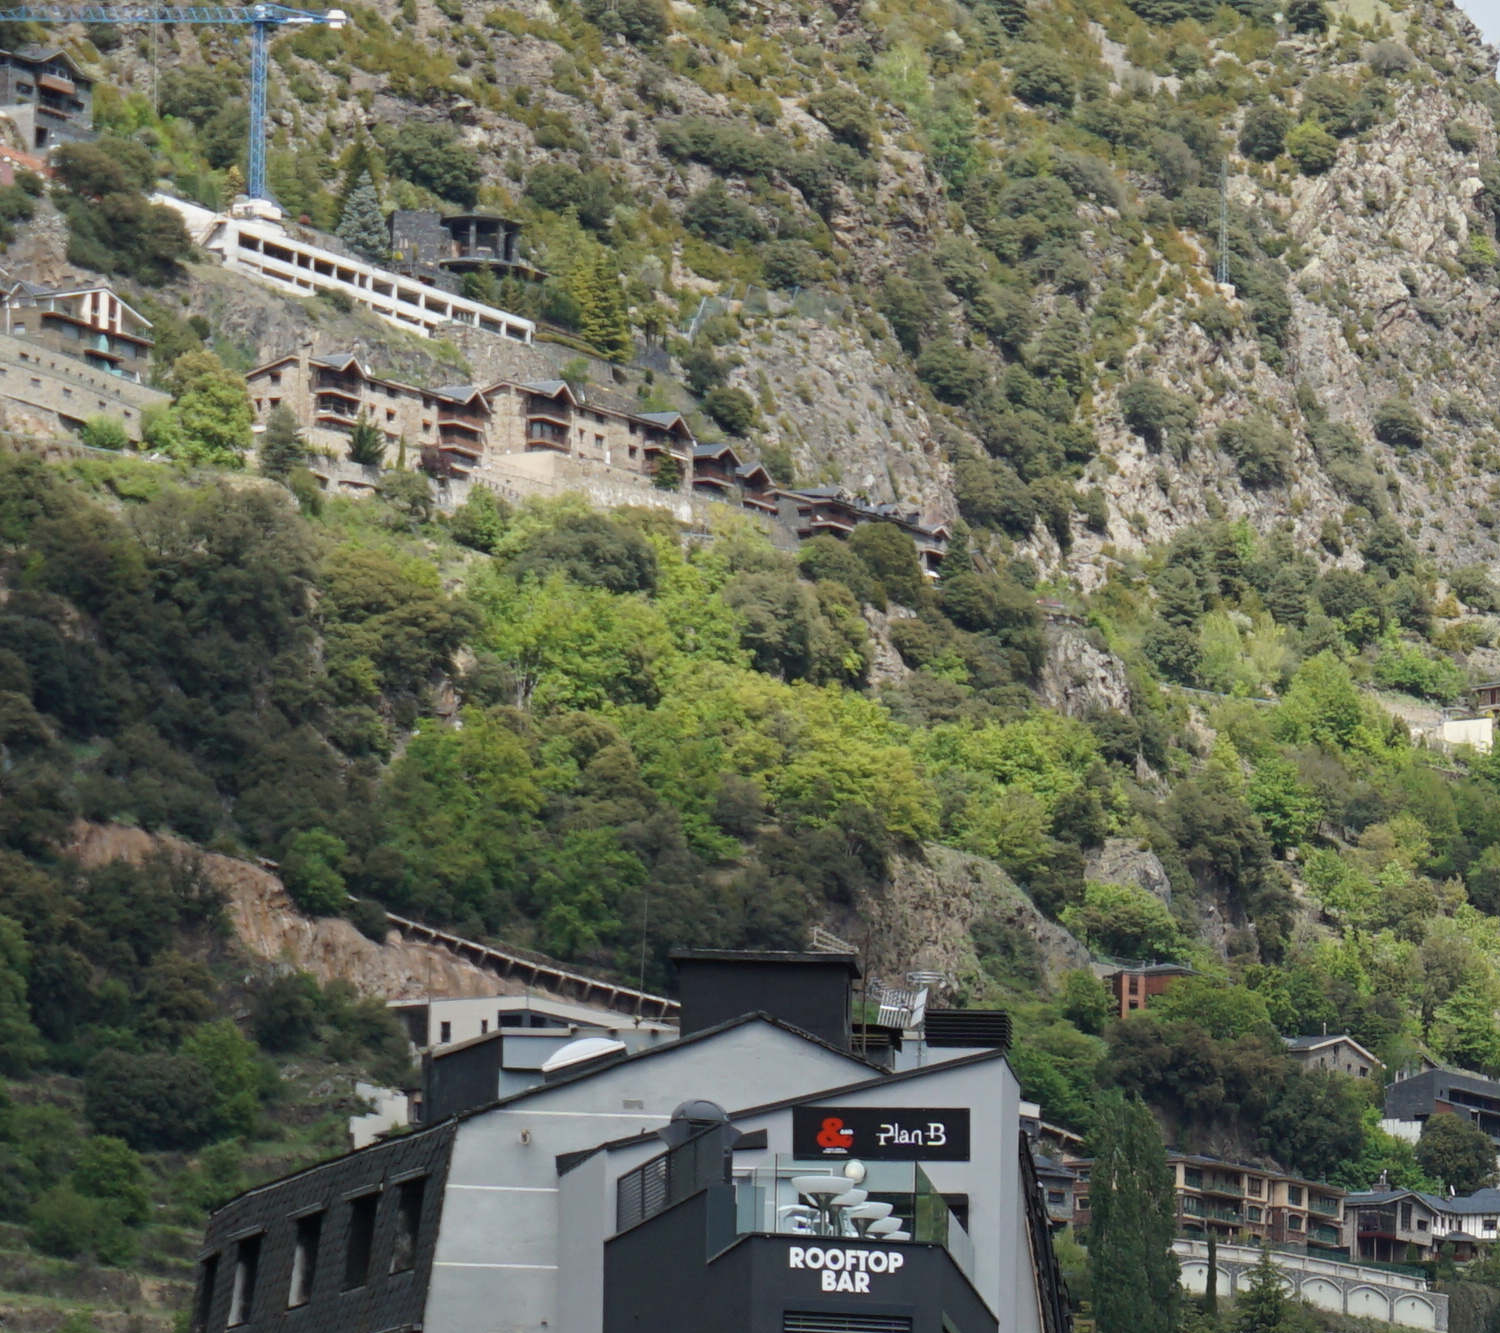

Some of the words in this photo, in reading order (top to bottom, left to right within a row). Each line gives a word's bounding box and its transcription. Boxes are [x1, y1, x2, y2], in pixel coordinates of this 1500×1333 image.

[876, 1122, 923, 1146] Plan
[925, 1122, 946, 1146] B
[789, 1246, 904, 1273] ROOFTOP
[821, 1269, 870, 1293] BAR
